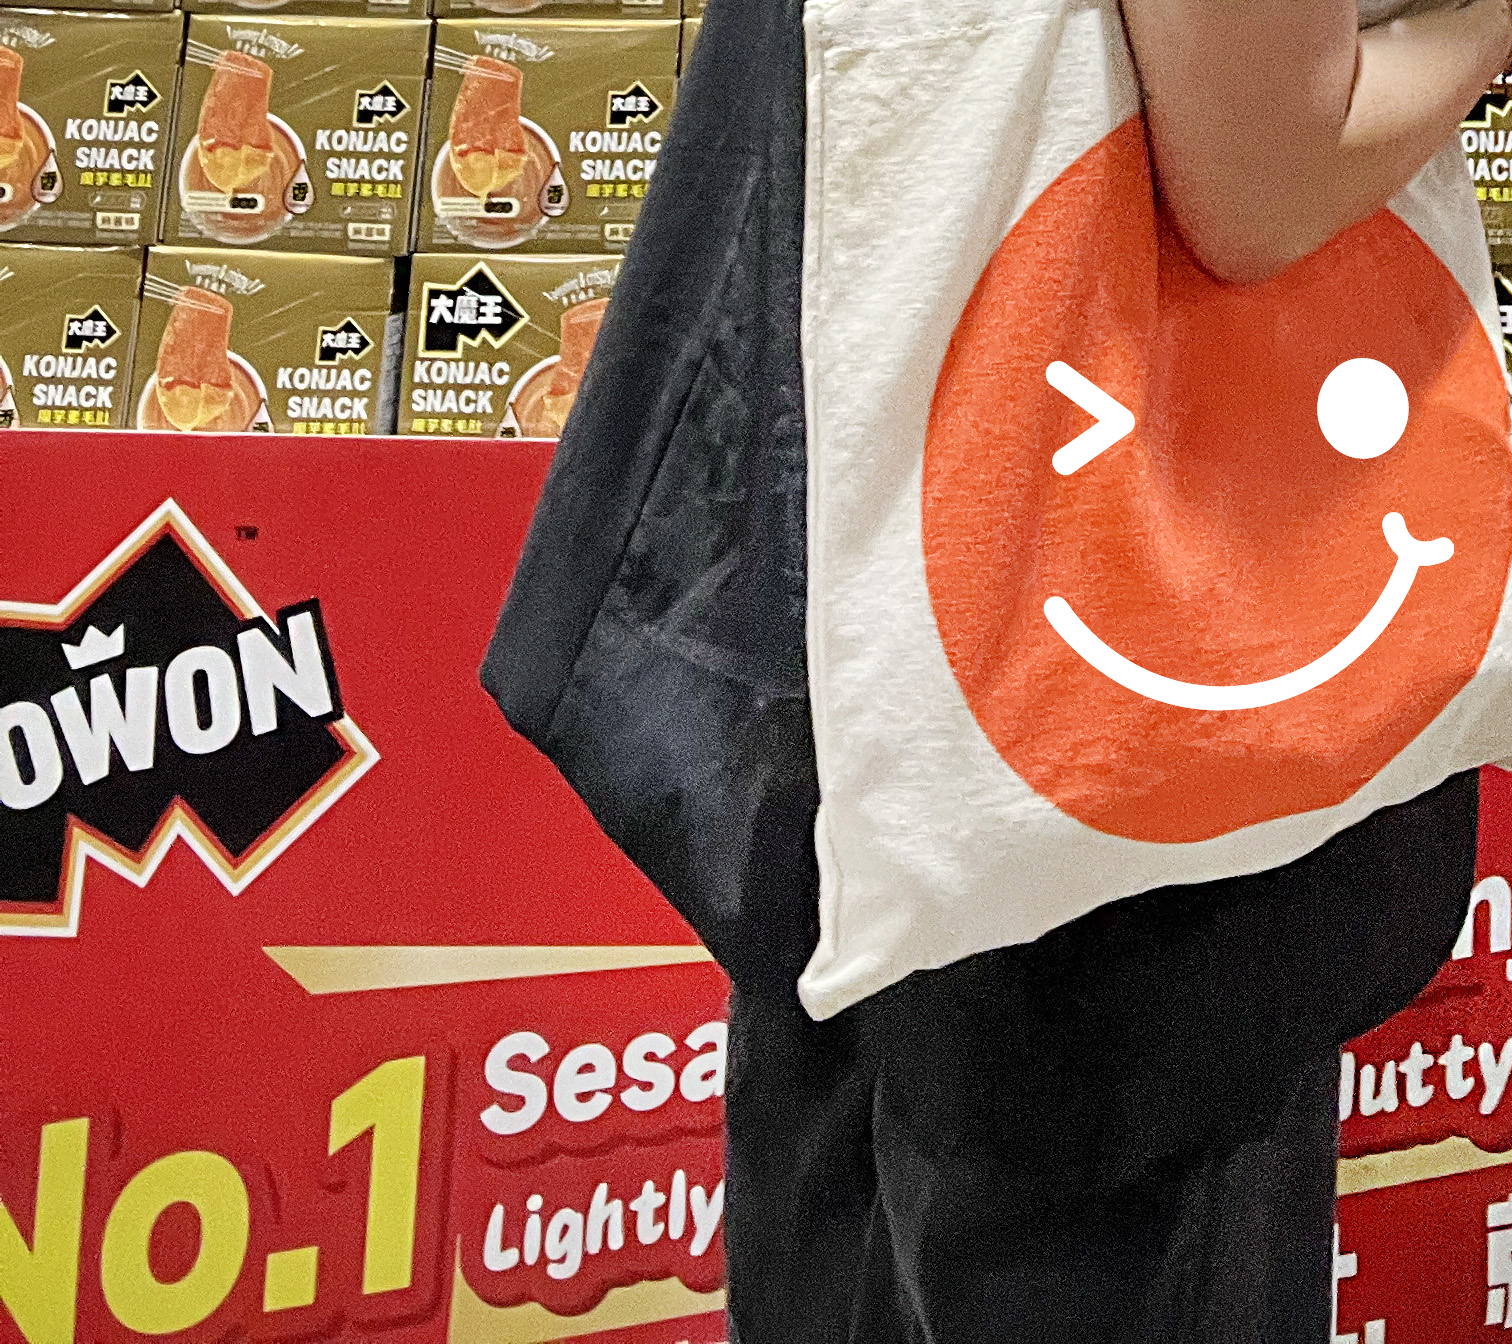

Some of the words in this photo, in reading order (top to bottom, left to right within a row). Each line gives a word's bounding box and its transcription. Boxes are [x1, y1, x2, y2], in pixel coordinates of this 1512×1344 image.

[65, 119, 158, 142] KONJAC
[316, 130, 407, 153] KONJAC
[570, 131, 661, 153] KONJAC
[76, 147, 154, 170] SNACK
[325, 158, 404, 180] SNACK
[23, 355, 117, 379] KONJAC
[414, 361, 509, 385] KONJAC
[277, 368, 371, 390] KONJAC
[33, 384, 113, 408] SNACK
[287, 396, 368, 419] SNACK
[412, 389, 493, 413] SNACK
[484, 1170, 724, 1280] Lightly
